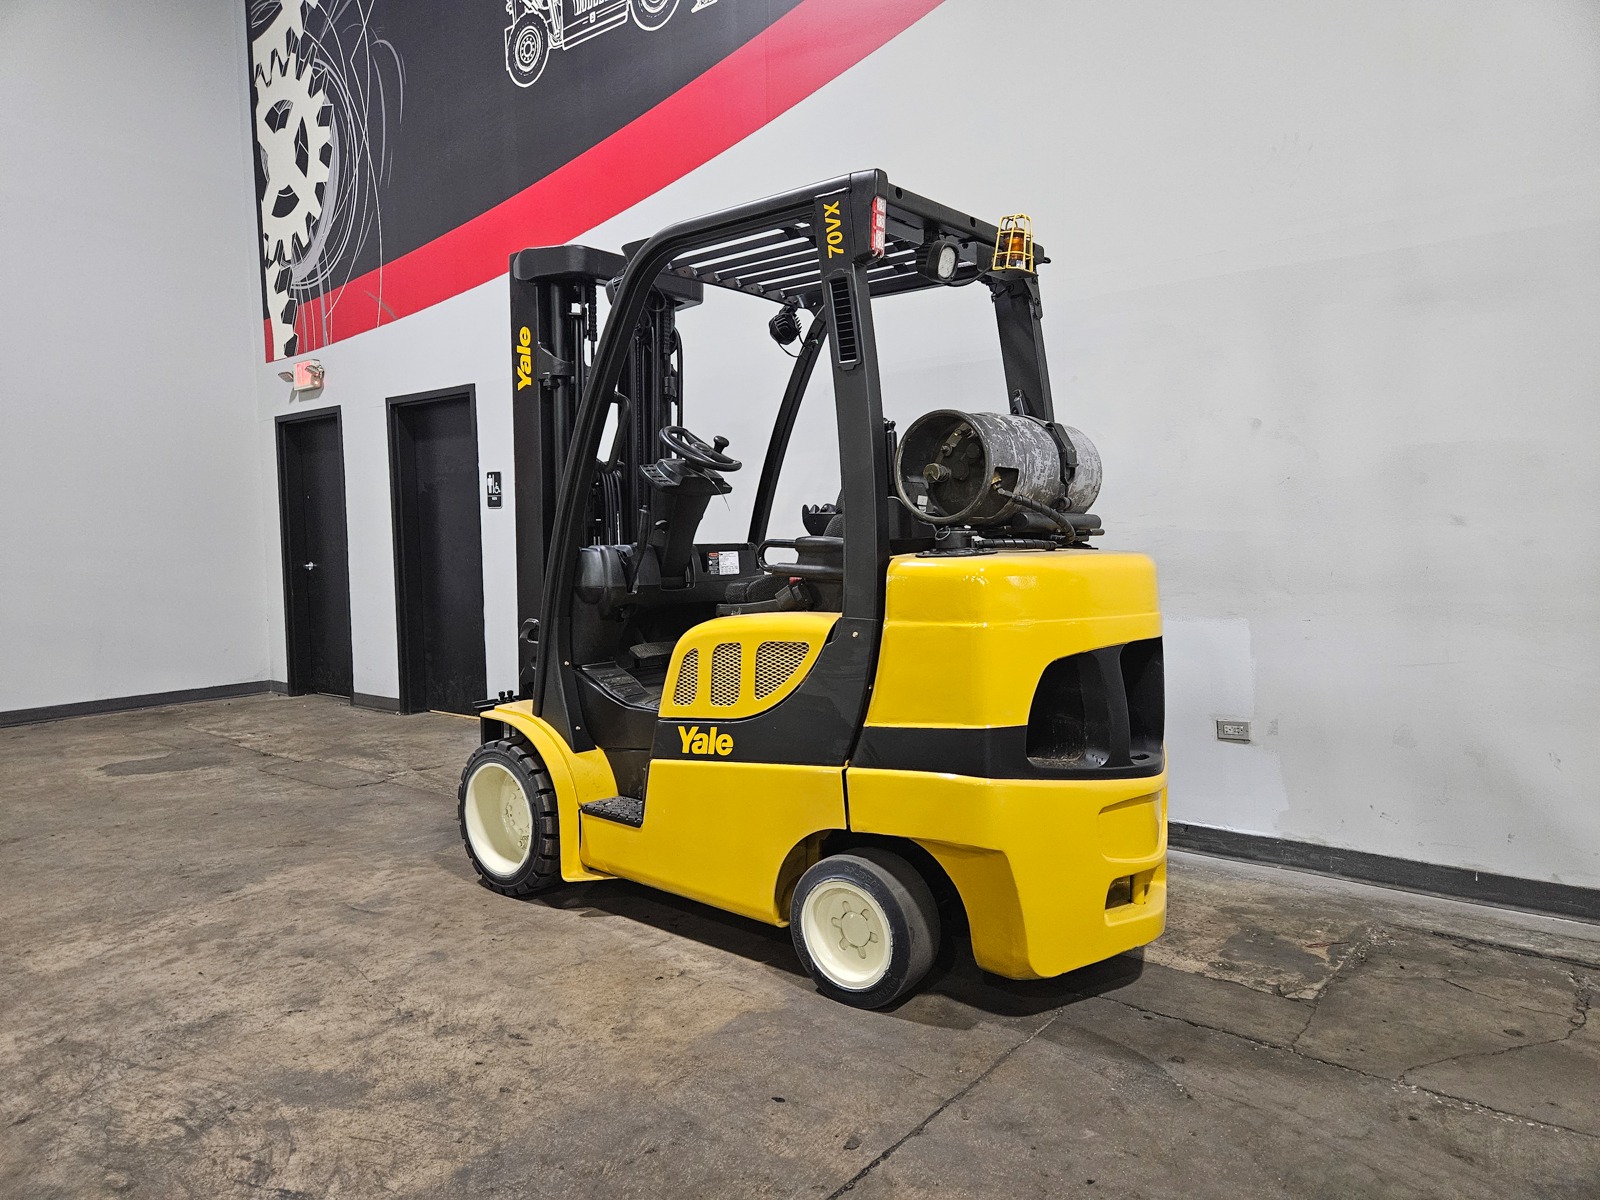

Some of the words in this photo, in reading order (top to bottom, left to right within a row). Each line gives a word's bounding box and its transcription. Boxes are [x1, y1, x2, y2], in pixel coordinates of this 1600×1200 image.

[823, 201, 844, 258] 70VX
[517, 326, 532, 391] Yale
[677, 725, 734, 756] Yale
